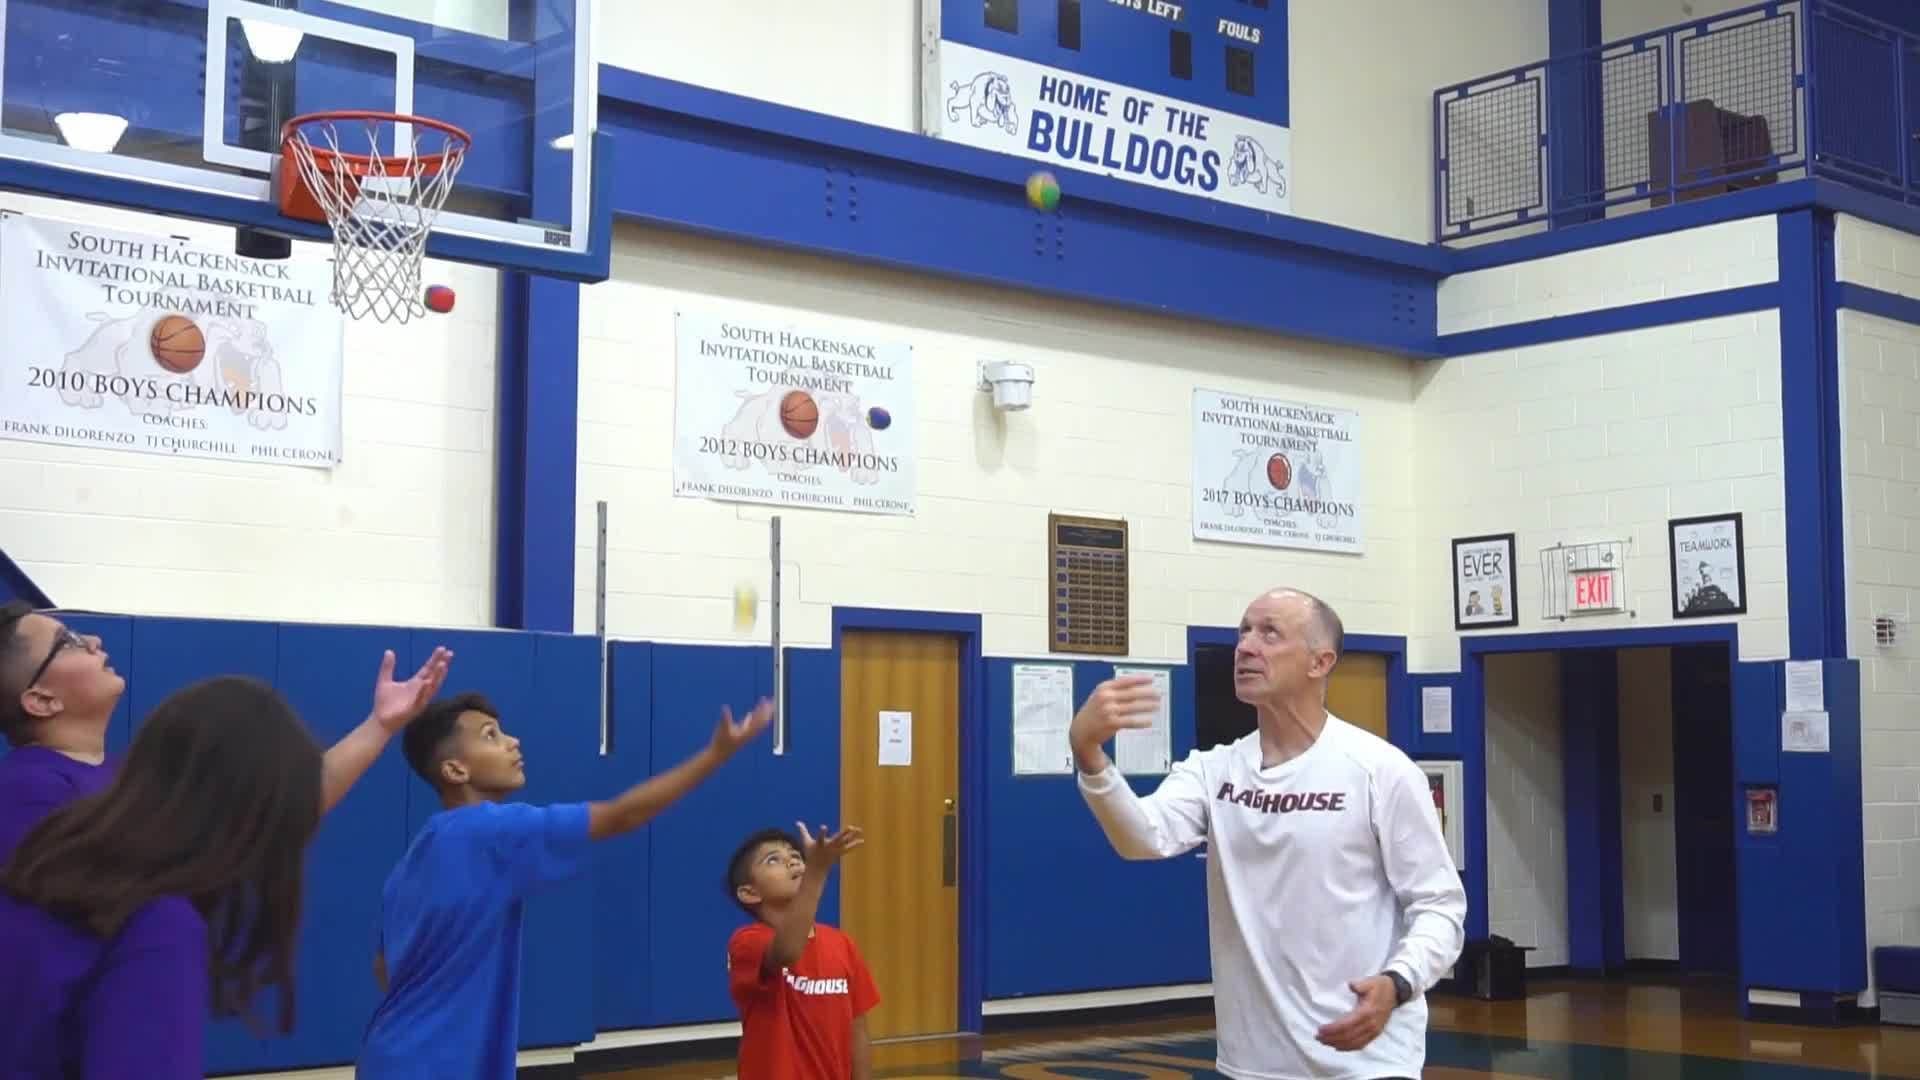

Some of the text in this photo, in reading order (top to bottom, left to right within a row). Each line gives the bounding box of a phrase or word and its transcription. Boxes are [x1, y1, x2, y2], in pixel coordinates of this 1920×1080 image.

[1147, 0, 1182, 21] LEFT
[1217, 19, 1261, 43] FOULS
[1039, 76, 1210, 140] HOME OF THE
[1027, 110, 1221, 192] BULLDOGS
[68, 231, 290, 280] SOUTH HACKENSACK
[37, 250, 315, 306] INVITATIONAL BASKETBALL
[103, 284, 257, 320] TOURNAMENT
[721, 324, 876, 360] SOUTH HACKENSACK
[700, 340, 895, 380] INVITATIONAL BASKETBALL
[28, 366, 318, 416] 2010 BOYS CHAMPIONS
[747, 366, 853, 394] TOURNAMENT
[1202, 411, 1353, 442] INVITATIONAL BASKETBALL
[1220, 399, 1335, 426] SOUTH HACKENSACK
[4, 420, 51, 436] FRANK
[54, 425, 136, 445] DILORENZO
[145, 435, 161, 449] TJ
[251, 445, 281, 458] PHIL
[699, 436, 899, 473] 2012 BOYS CHAMPIONS
[1241, 432, 1319, 453] TOURNAMENT
[1202, 488, 1355, 517] 2017 BOYS CHAMPIONS
[1680, 538, 1732, 552] TEAMWORK
[1463, 552, 1503, 577] EVER
[1576, 575, 1613, 604] EXIT
